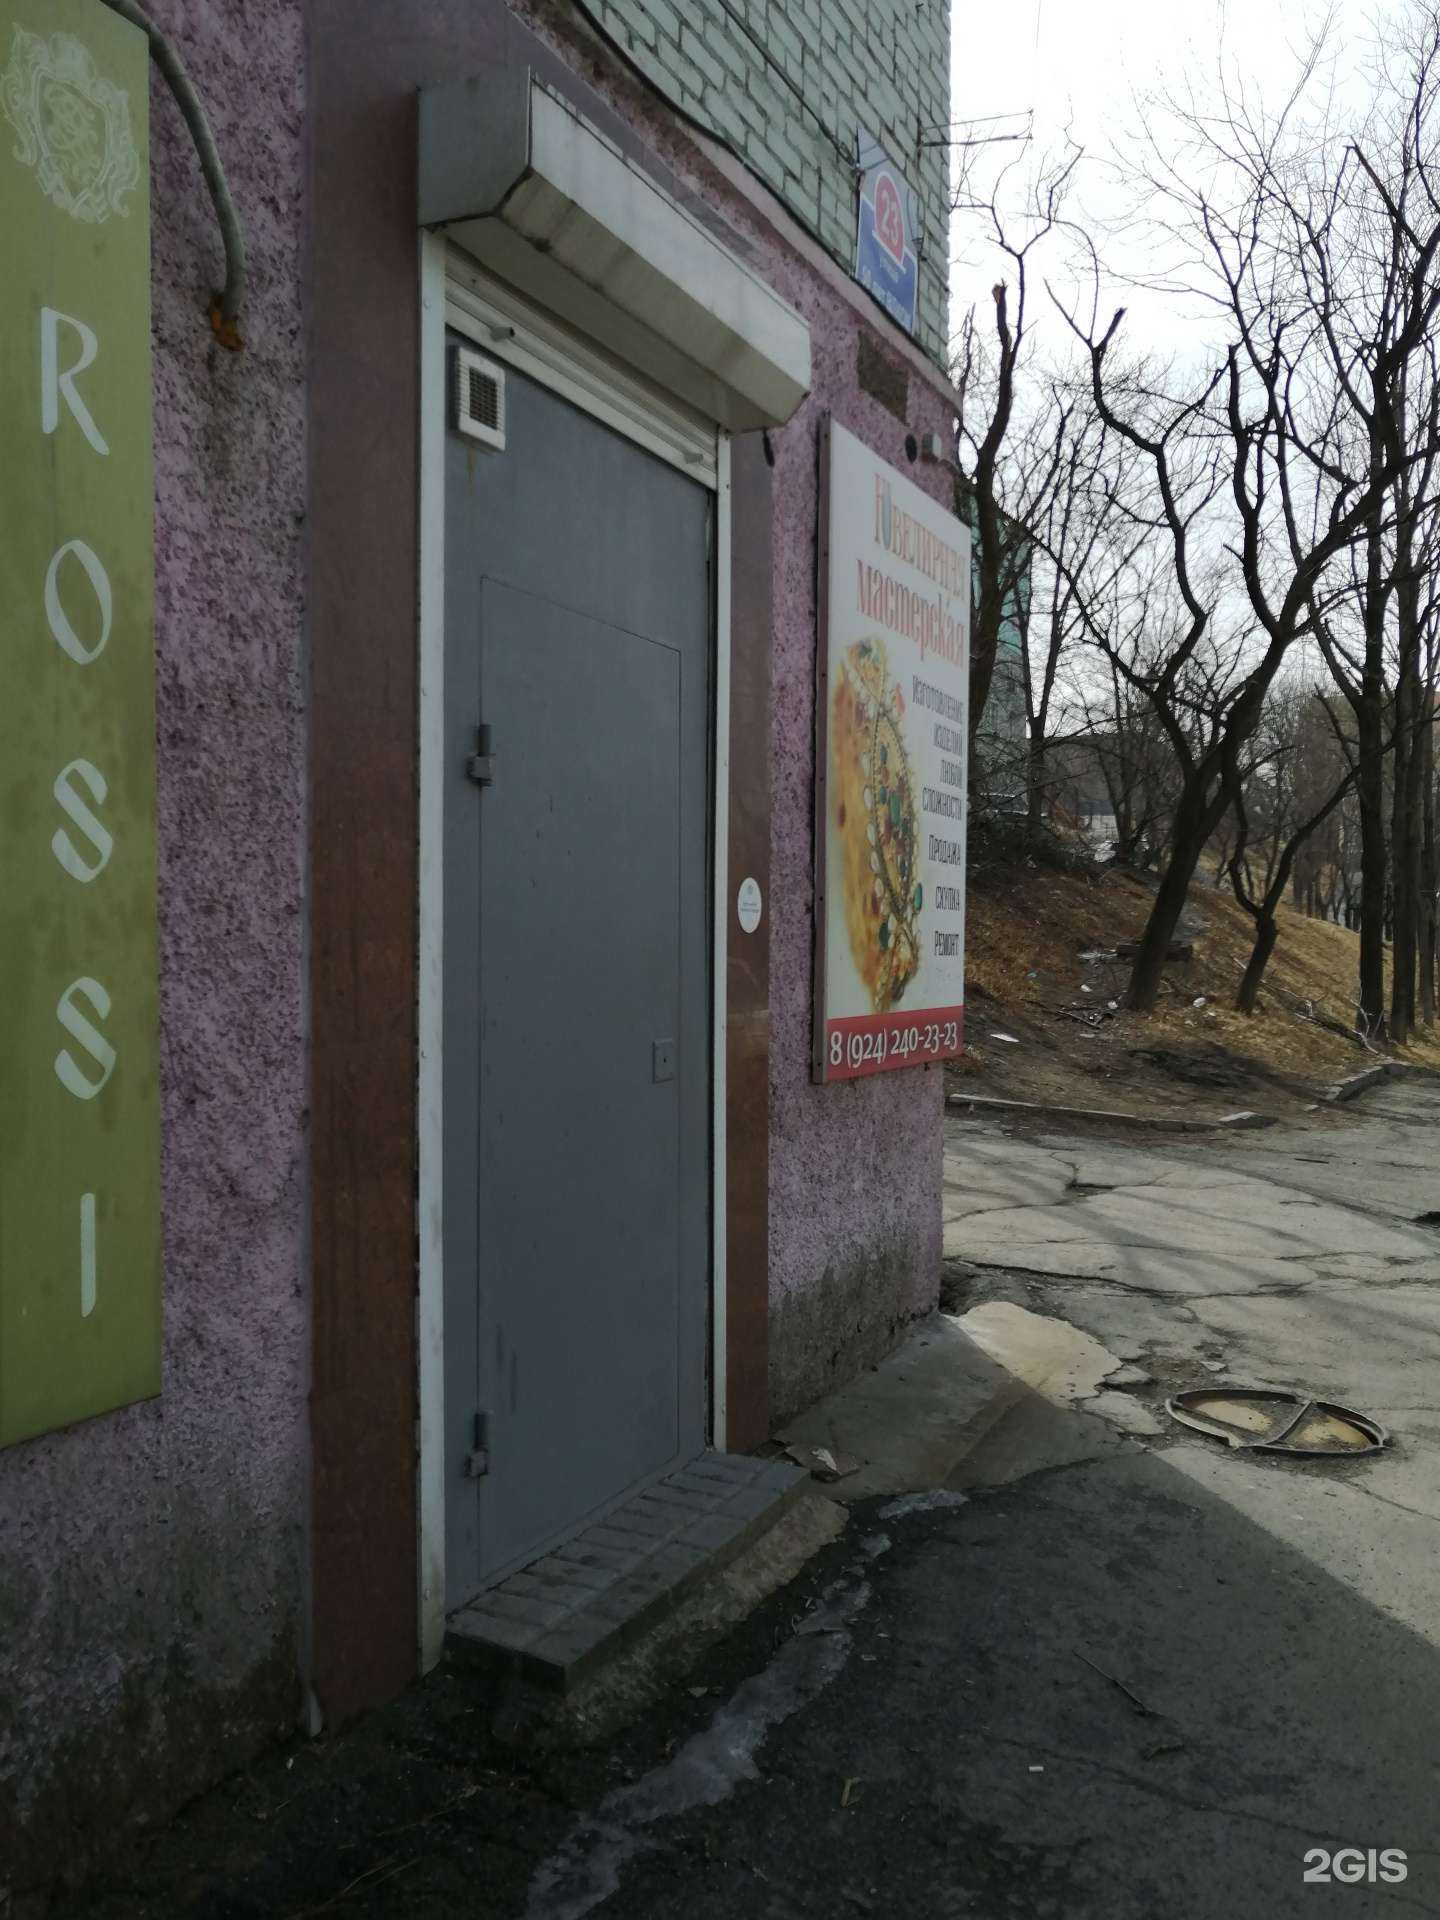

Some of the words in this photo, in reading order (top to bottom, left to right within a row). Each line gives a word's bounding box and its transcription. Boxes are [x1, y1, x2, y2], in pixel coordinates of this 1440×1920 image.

[41, 306, 117, 1318] ROSSI
[830, 1031, 843, 1066] 8
[847, 1028, 887, 1069] (924)
[890, 1021, 957, 1059] 240-23-23
